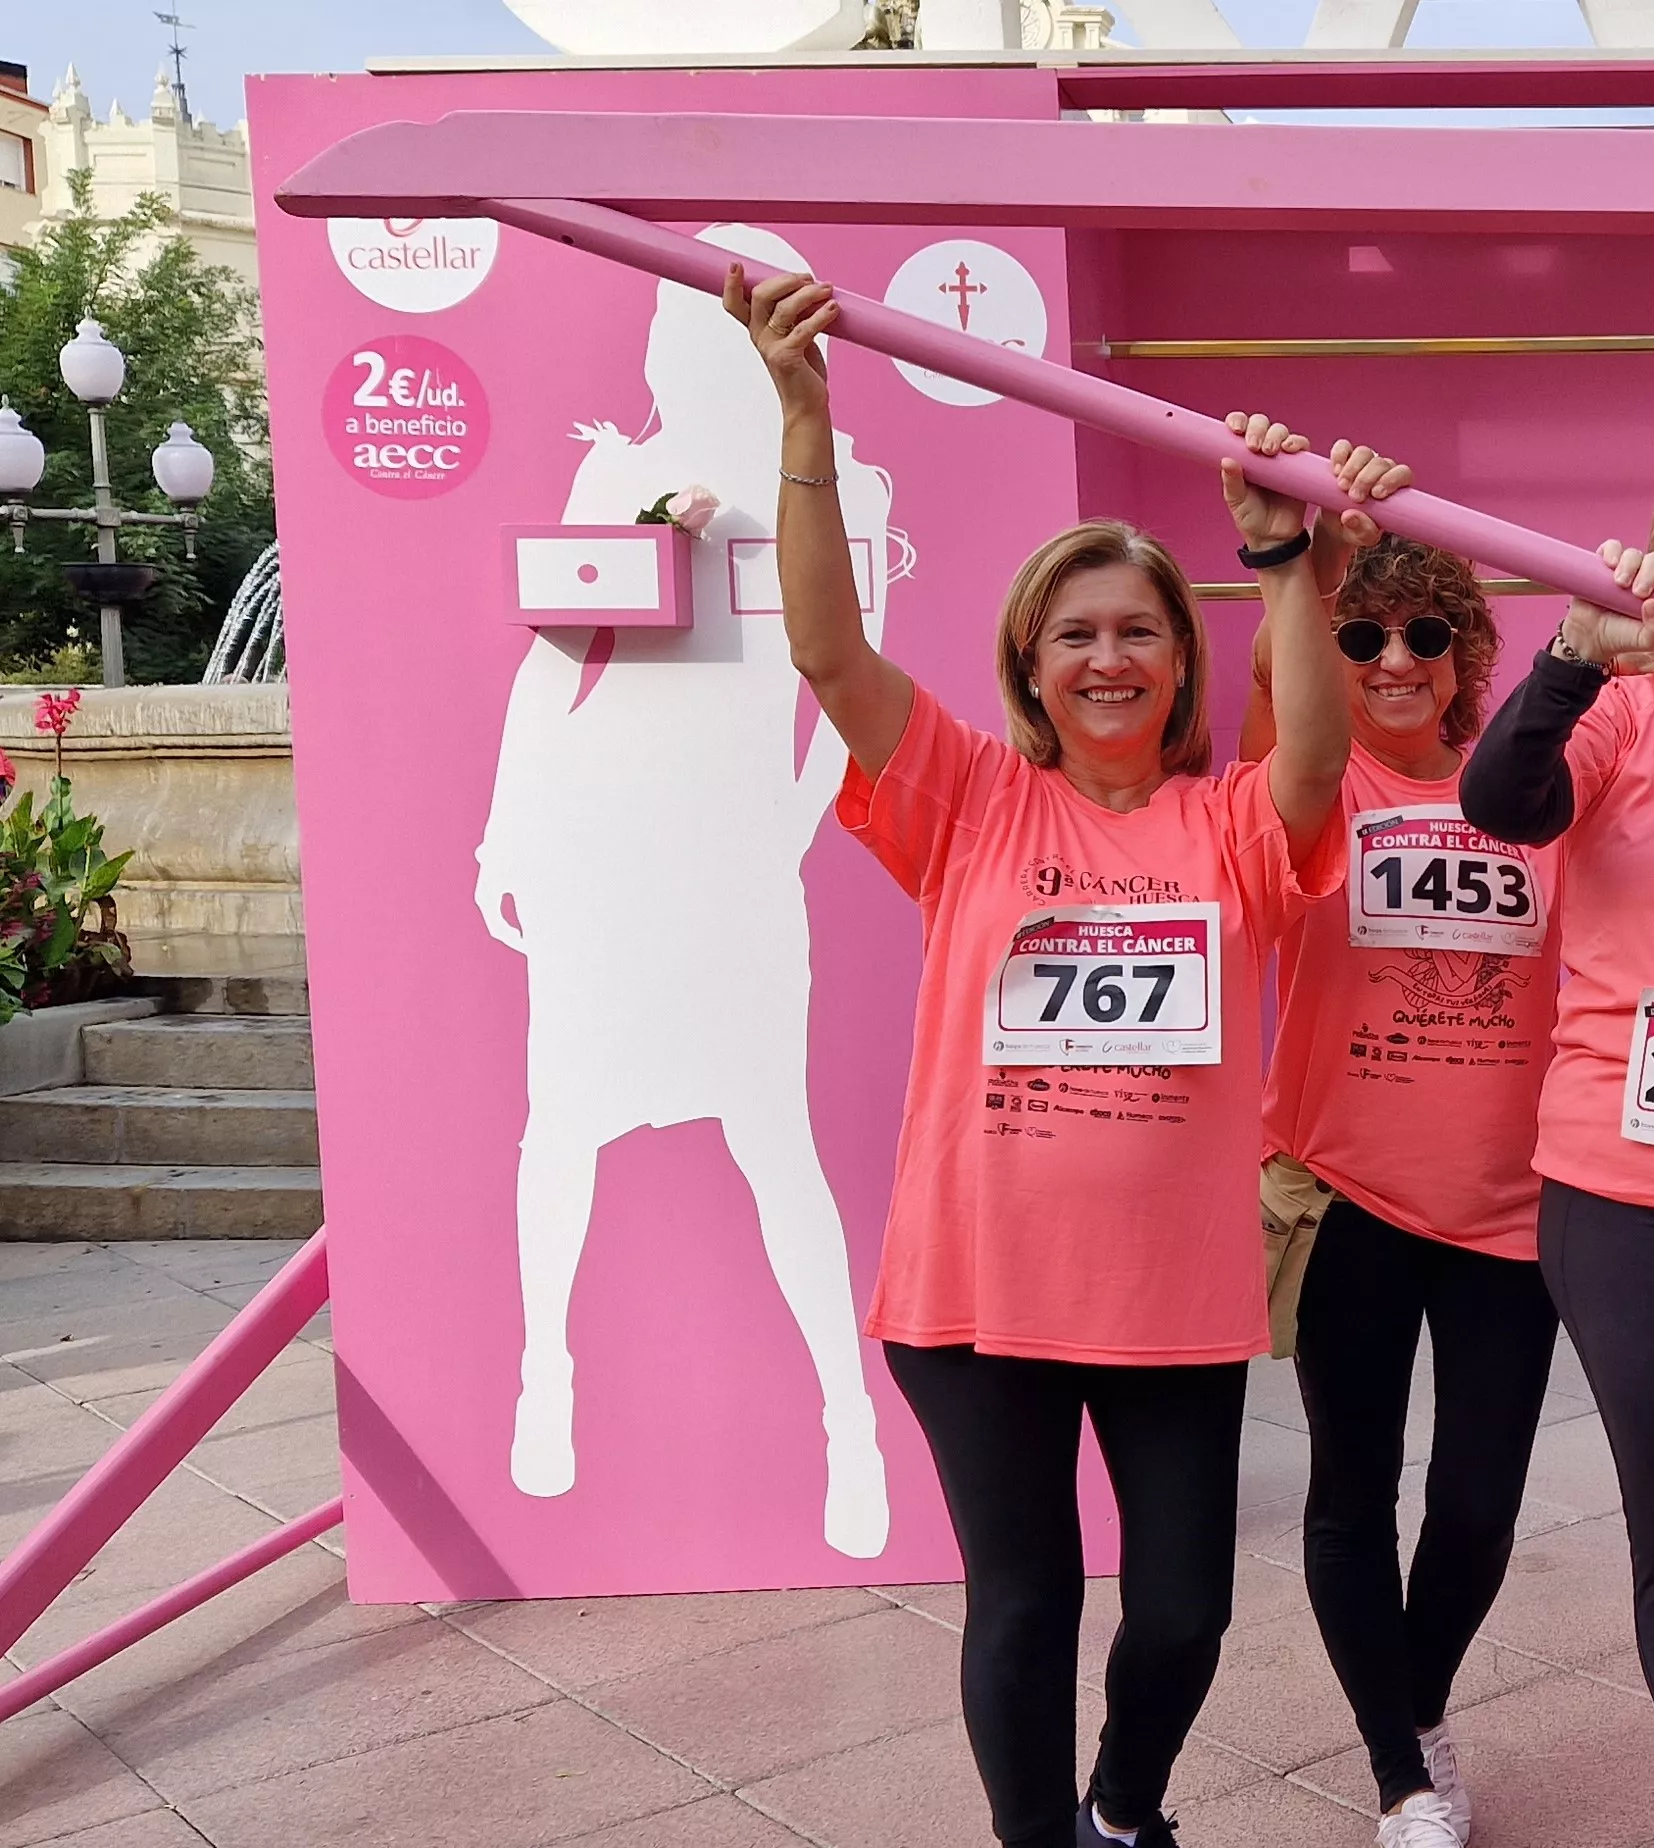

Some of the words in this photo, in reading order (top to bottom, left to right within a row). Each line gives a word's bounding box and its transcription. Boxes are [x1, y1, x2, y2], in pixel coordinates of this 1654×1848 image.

[348, 236, 481, 270] castellar
[345, 417, 359, 434] a
[365, 412, 466, 436] beneficio
[353, 443, 461, 470] aecc
[370, 468, 400, 479] Contra
[1429, 821, 1477, 834] HUESCA
[1371, 833, 1442, 849] CONTRA
[1446, 835, 1462, 848] EL
[1468, 834, 1521, 860] CÁNCER
[1080, 871, 1181, 896] CÁNCER
[1370, 857, 1530, 918] 1453
[1079, 925, 1133, 937] HUESCA
[1019, 938, 1092, 953] CONTRA
[1097, 939, 1119, 953] EL
[1122, 935, 1197, 953] CÁNCER
[1033, 964, 1175, 1023] 767
[1392, 1008, 1466, 1028] QUIÉRETE
[1468, 1014, 1516, 1029] MUCHO
[1114, 1041, 1153, 1052] castellar
